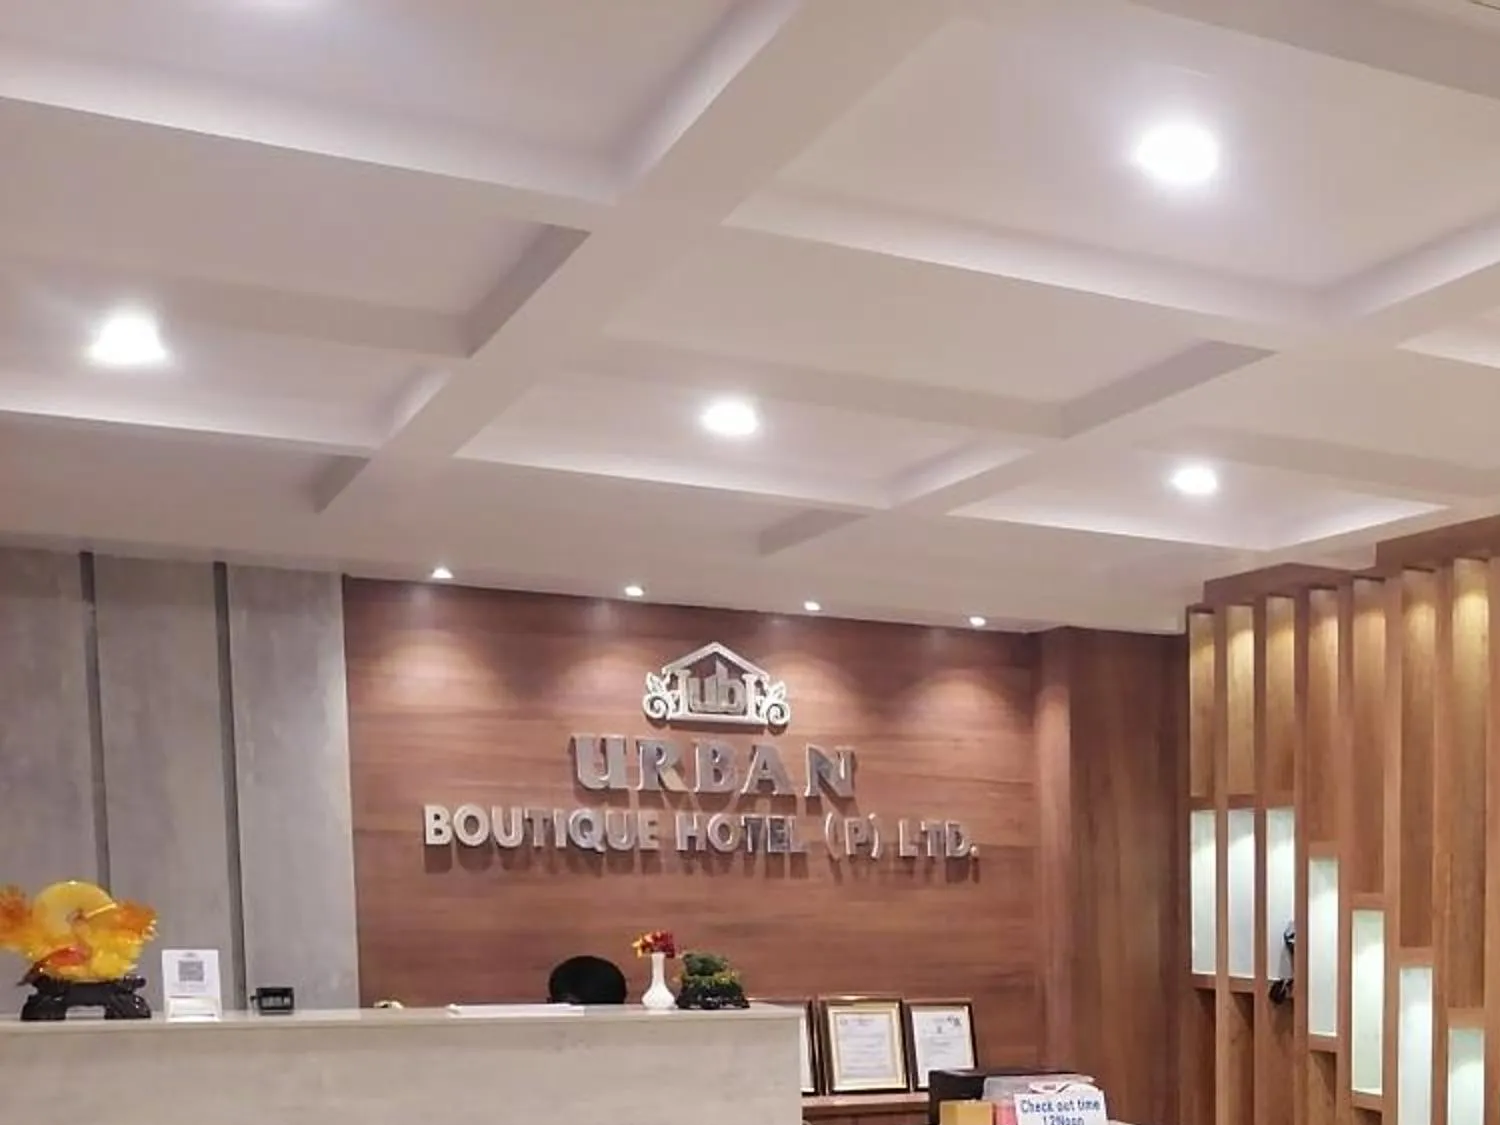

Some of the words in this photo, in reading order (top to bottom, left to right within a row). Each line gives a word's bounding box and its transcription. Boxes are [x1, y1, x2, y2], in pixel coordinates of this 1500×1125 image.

[571, 733, 856, 797] URBAN
[423, 803, 660, 853] BOUTIQUE
[675, 811, 808, 854] HOTEL
[824, 811, 880, 861] (P)
[899, 819, 980, 859] LTD.
[1020, 1099, 1053, 1114] Check
[1057, 1099, 1075, 1113] out
[1077, 1099, 1101, 1112] time
